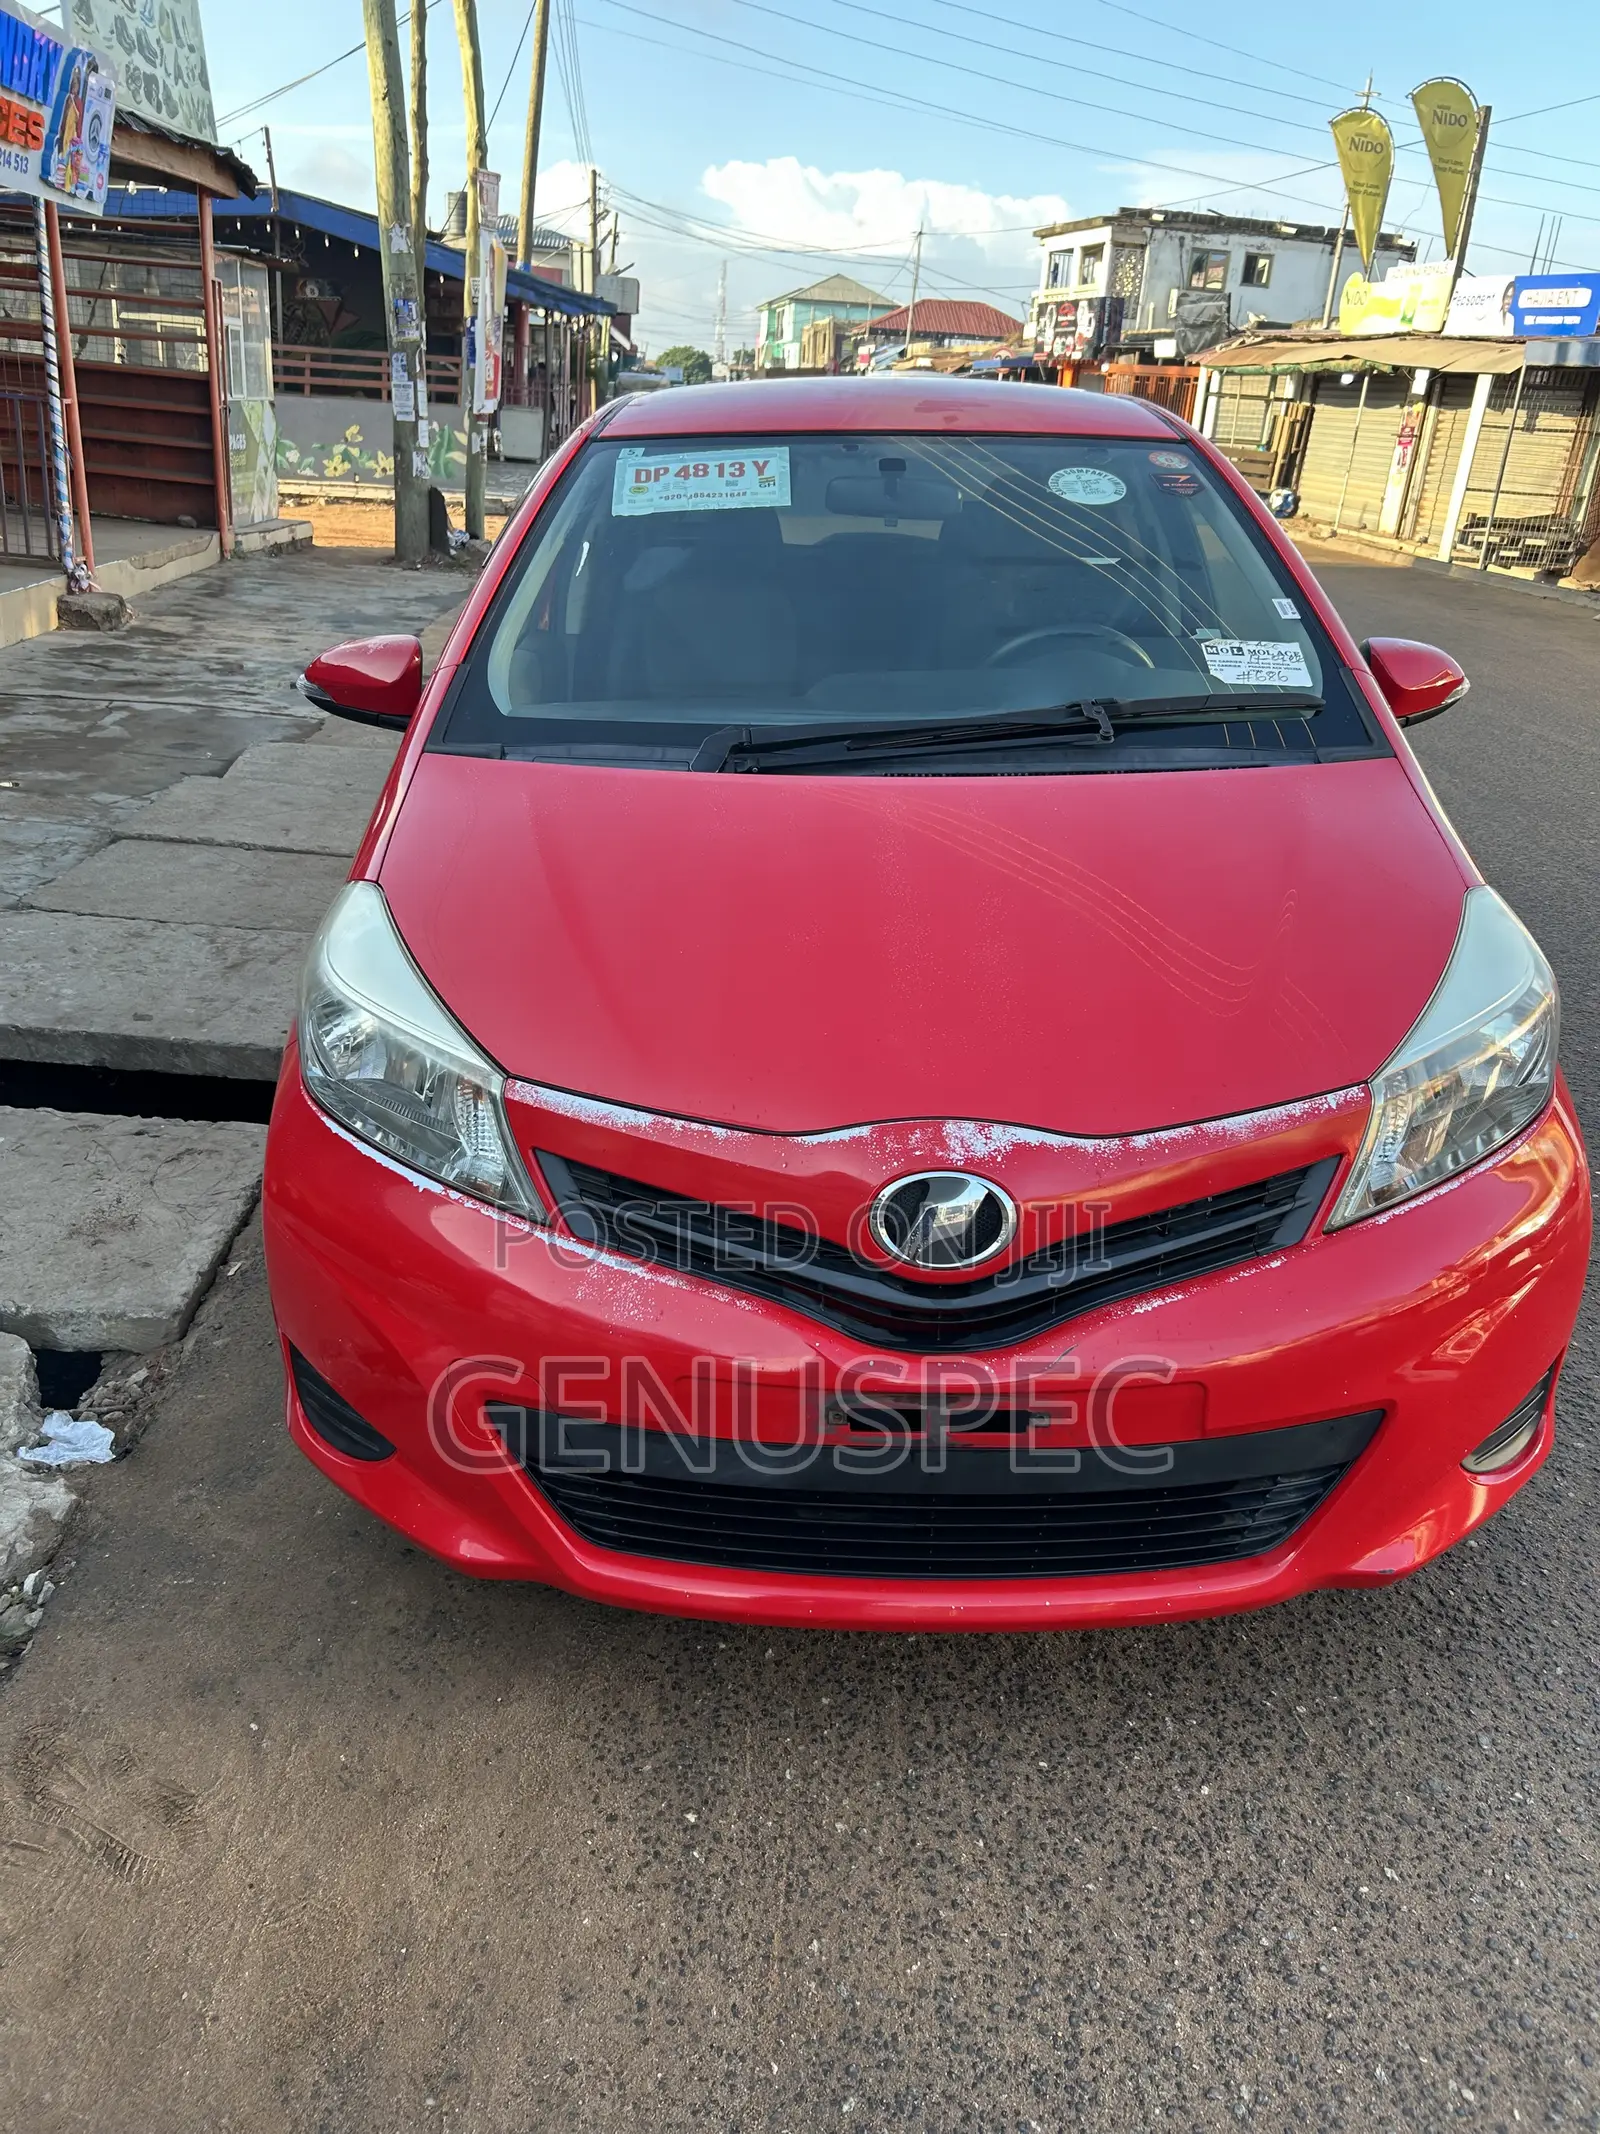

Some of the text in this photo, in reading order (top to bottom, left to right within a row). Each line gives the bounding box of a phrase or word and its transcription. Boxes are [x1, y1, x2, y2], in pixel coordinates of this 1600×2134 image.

[1432, 110, 1468, 128] NIDO
[1349, 136, 1384, 154] NIDO
[14, 153, 29, 174] 513
[634, 460, 770, 484] DP 4813 Y
[1064, 467, 1109, 479] COMPANY
[1107, 477, 1126, 496] LIMITED
